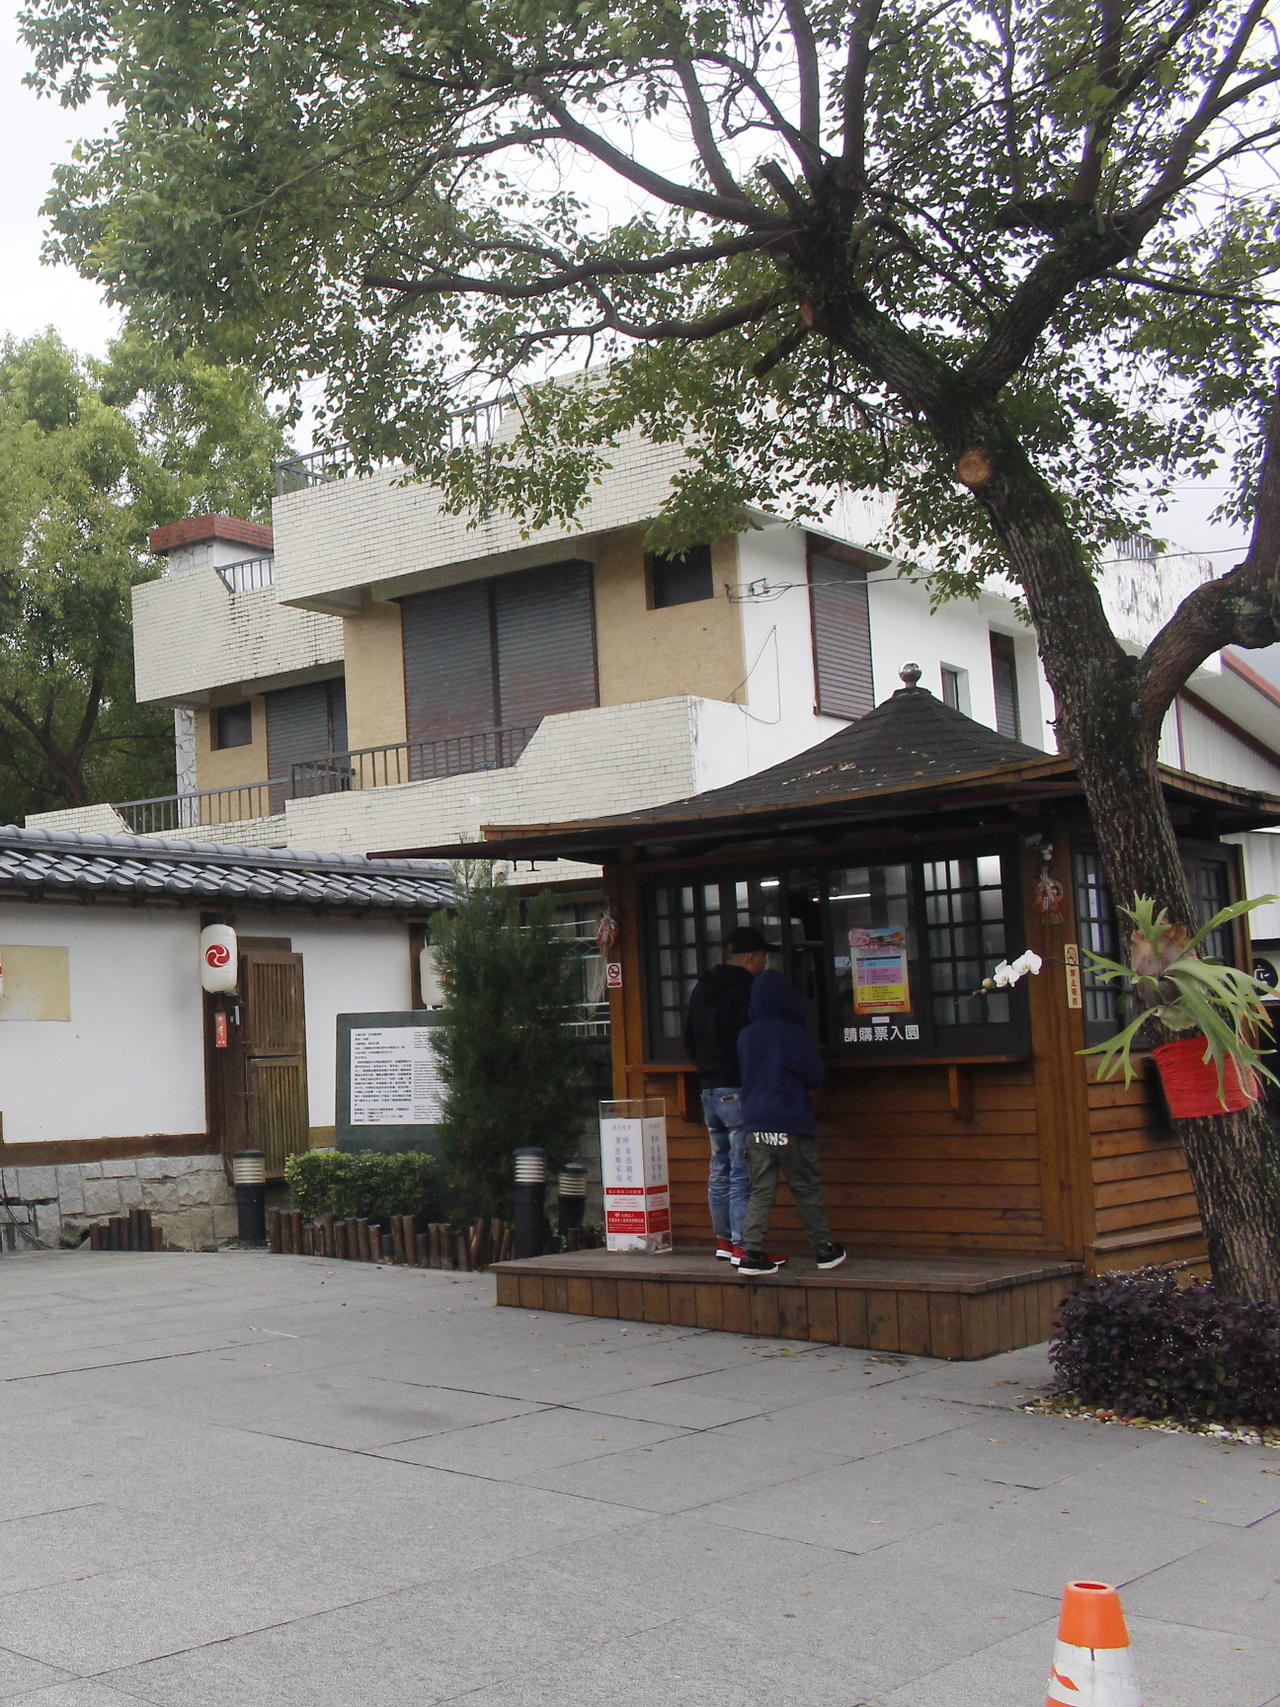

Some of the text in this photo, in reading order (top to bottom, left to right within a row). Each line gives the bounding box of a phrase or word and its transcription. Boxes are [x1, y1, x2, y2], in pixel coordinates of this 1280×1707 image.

[843, 1025, 920, 1042] 請購票入園
